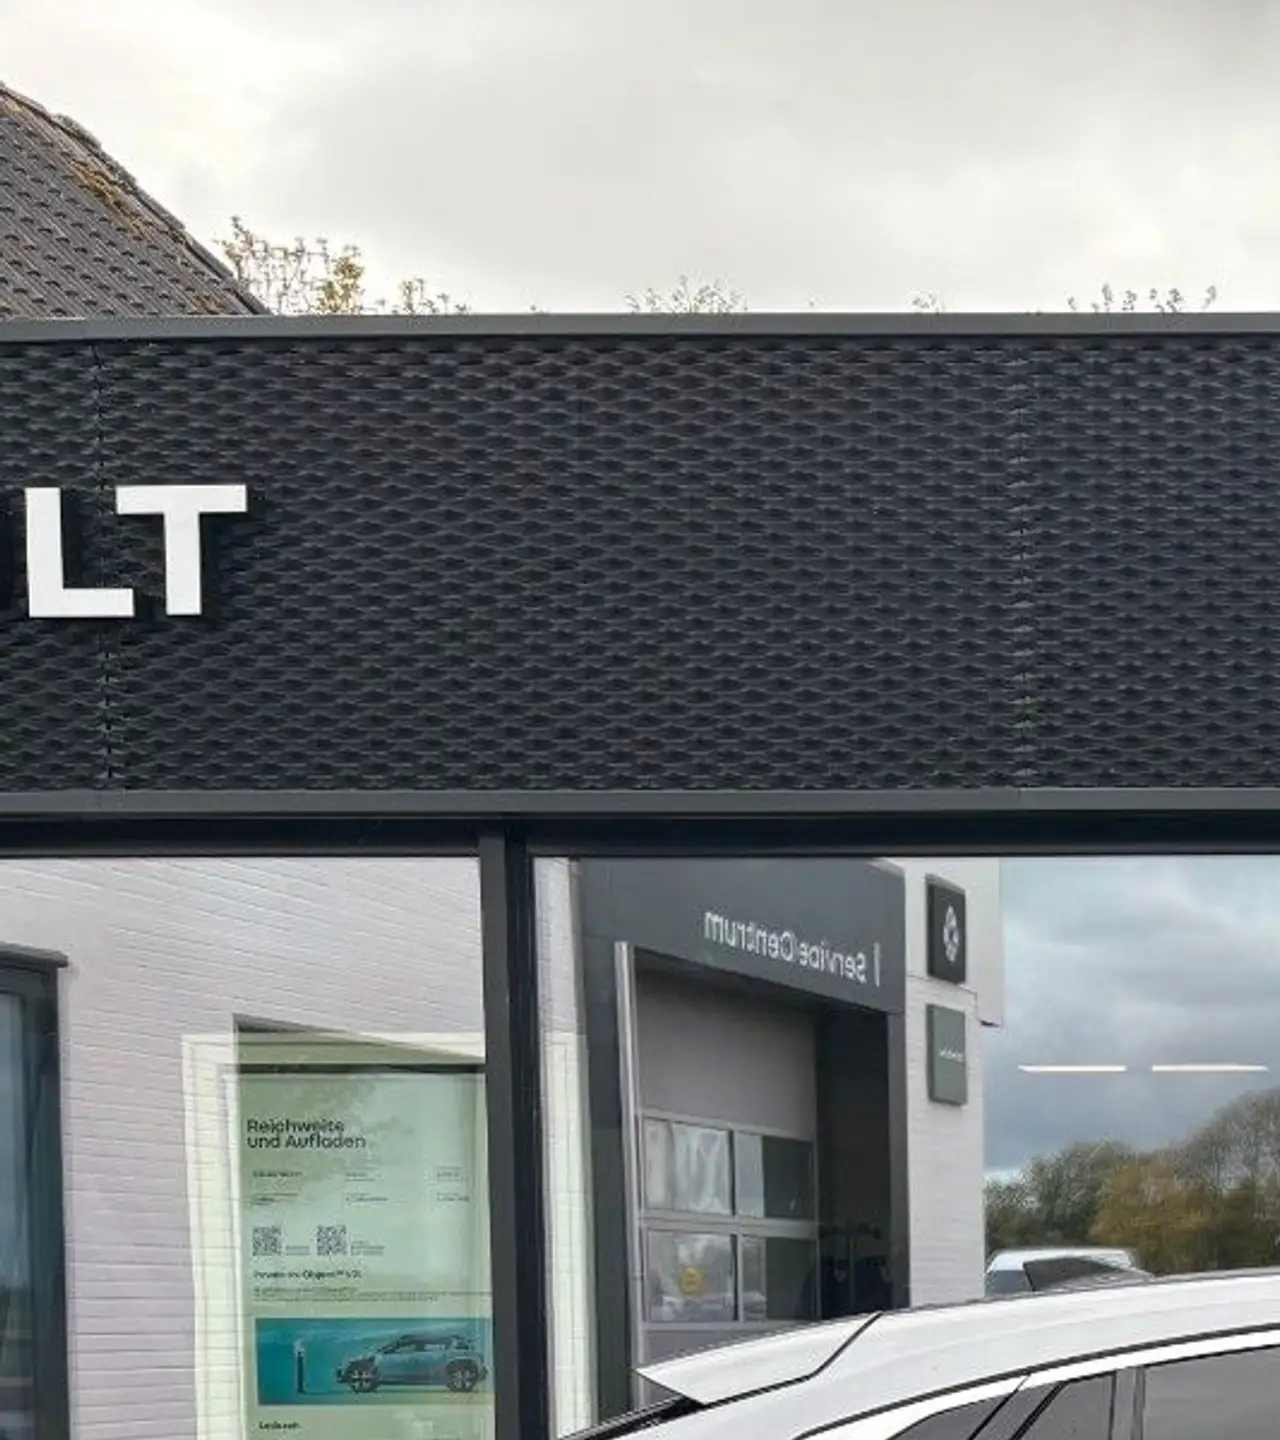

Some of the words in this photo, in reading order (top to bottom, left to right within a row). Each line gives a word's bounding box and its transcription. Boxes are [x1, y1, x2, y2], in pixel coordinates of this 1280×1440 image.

[24, 484, 248, 618] LT
[246, 1118, 345, 1133] Reichweite
[246, 1134, 281, 1149] und
[285, 1131, 367, 1149] Aufladen
